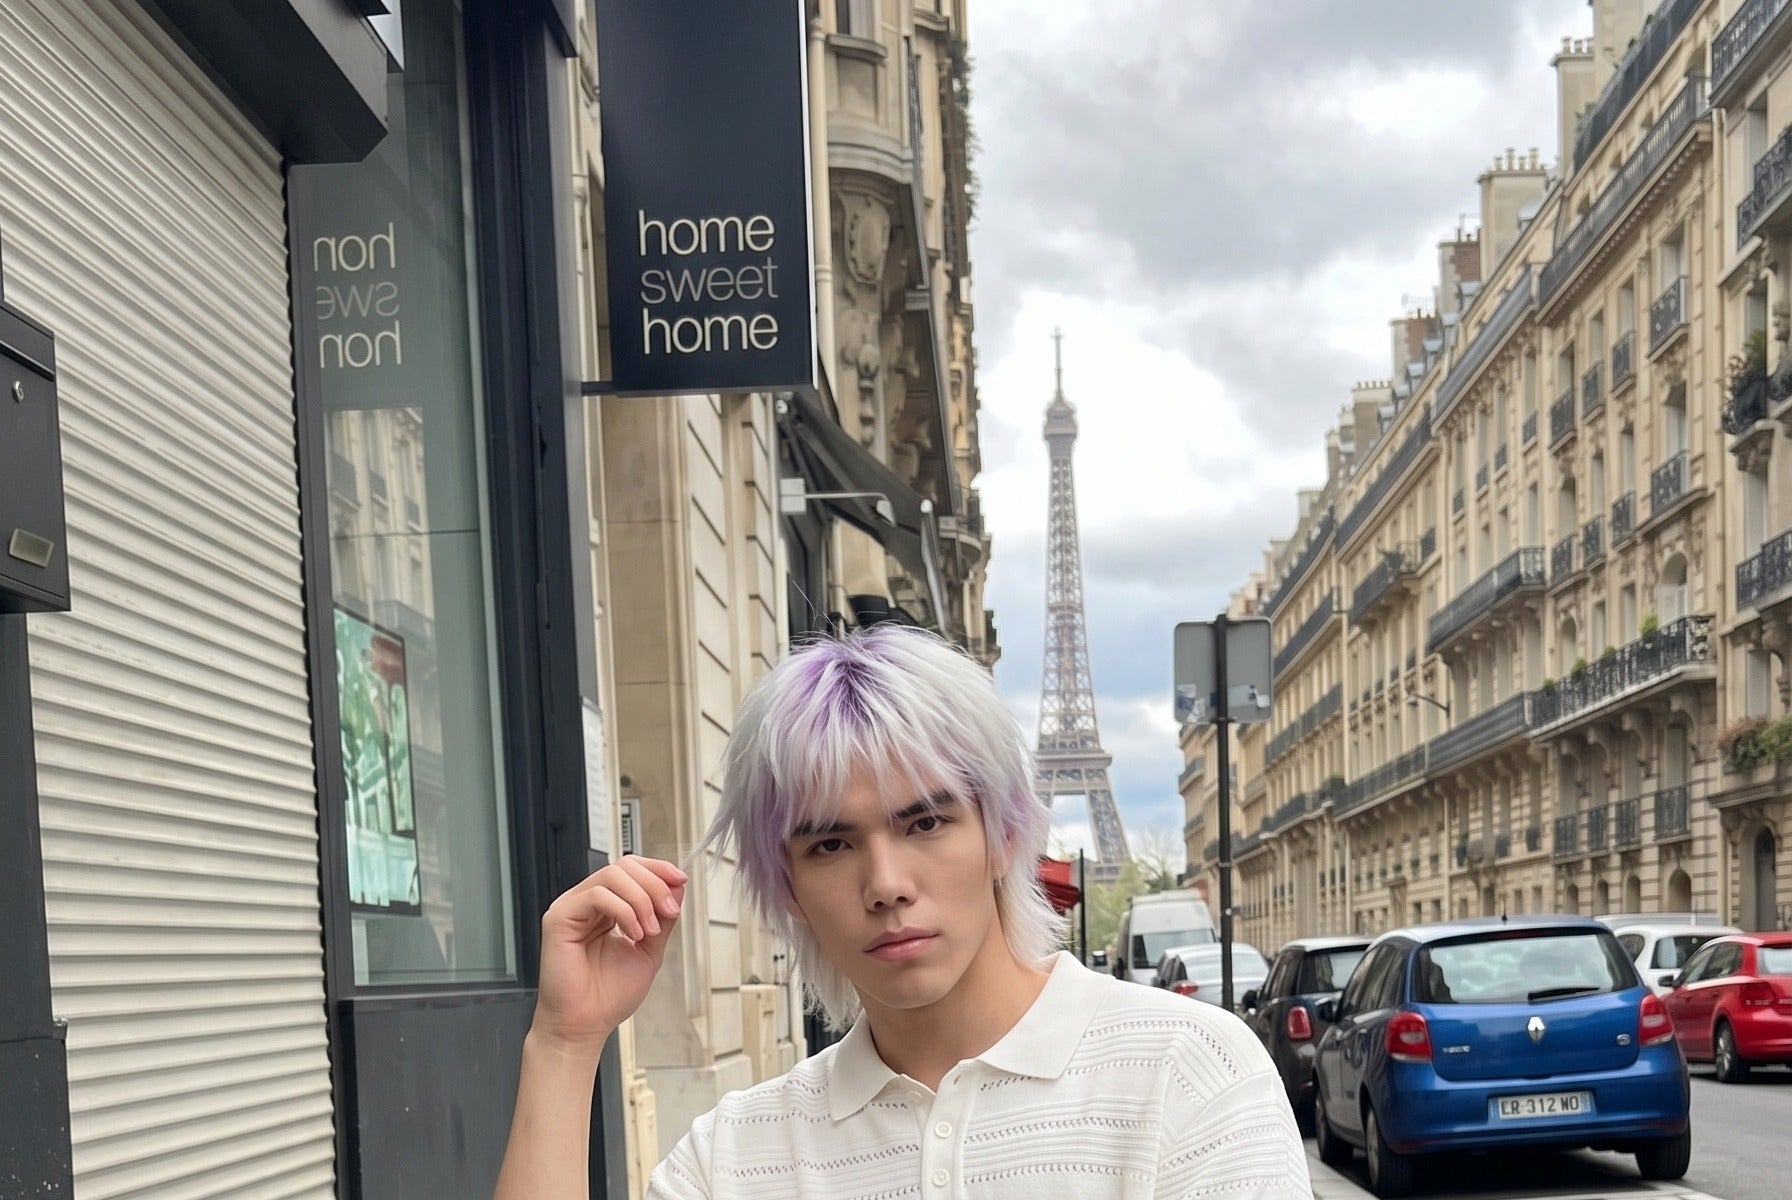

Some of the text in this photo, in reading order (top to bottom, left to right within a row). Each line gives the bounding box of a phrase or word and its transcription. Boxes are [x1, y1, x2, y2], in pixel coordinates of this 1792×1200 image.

[638, 209, 775, 256] home
[640, 256, 779, 304] sweet
[642, 307, 779, 355] home
